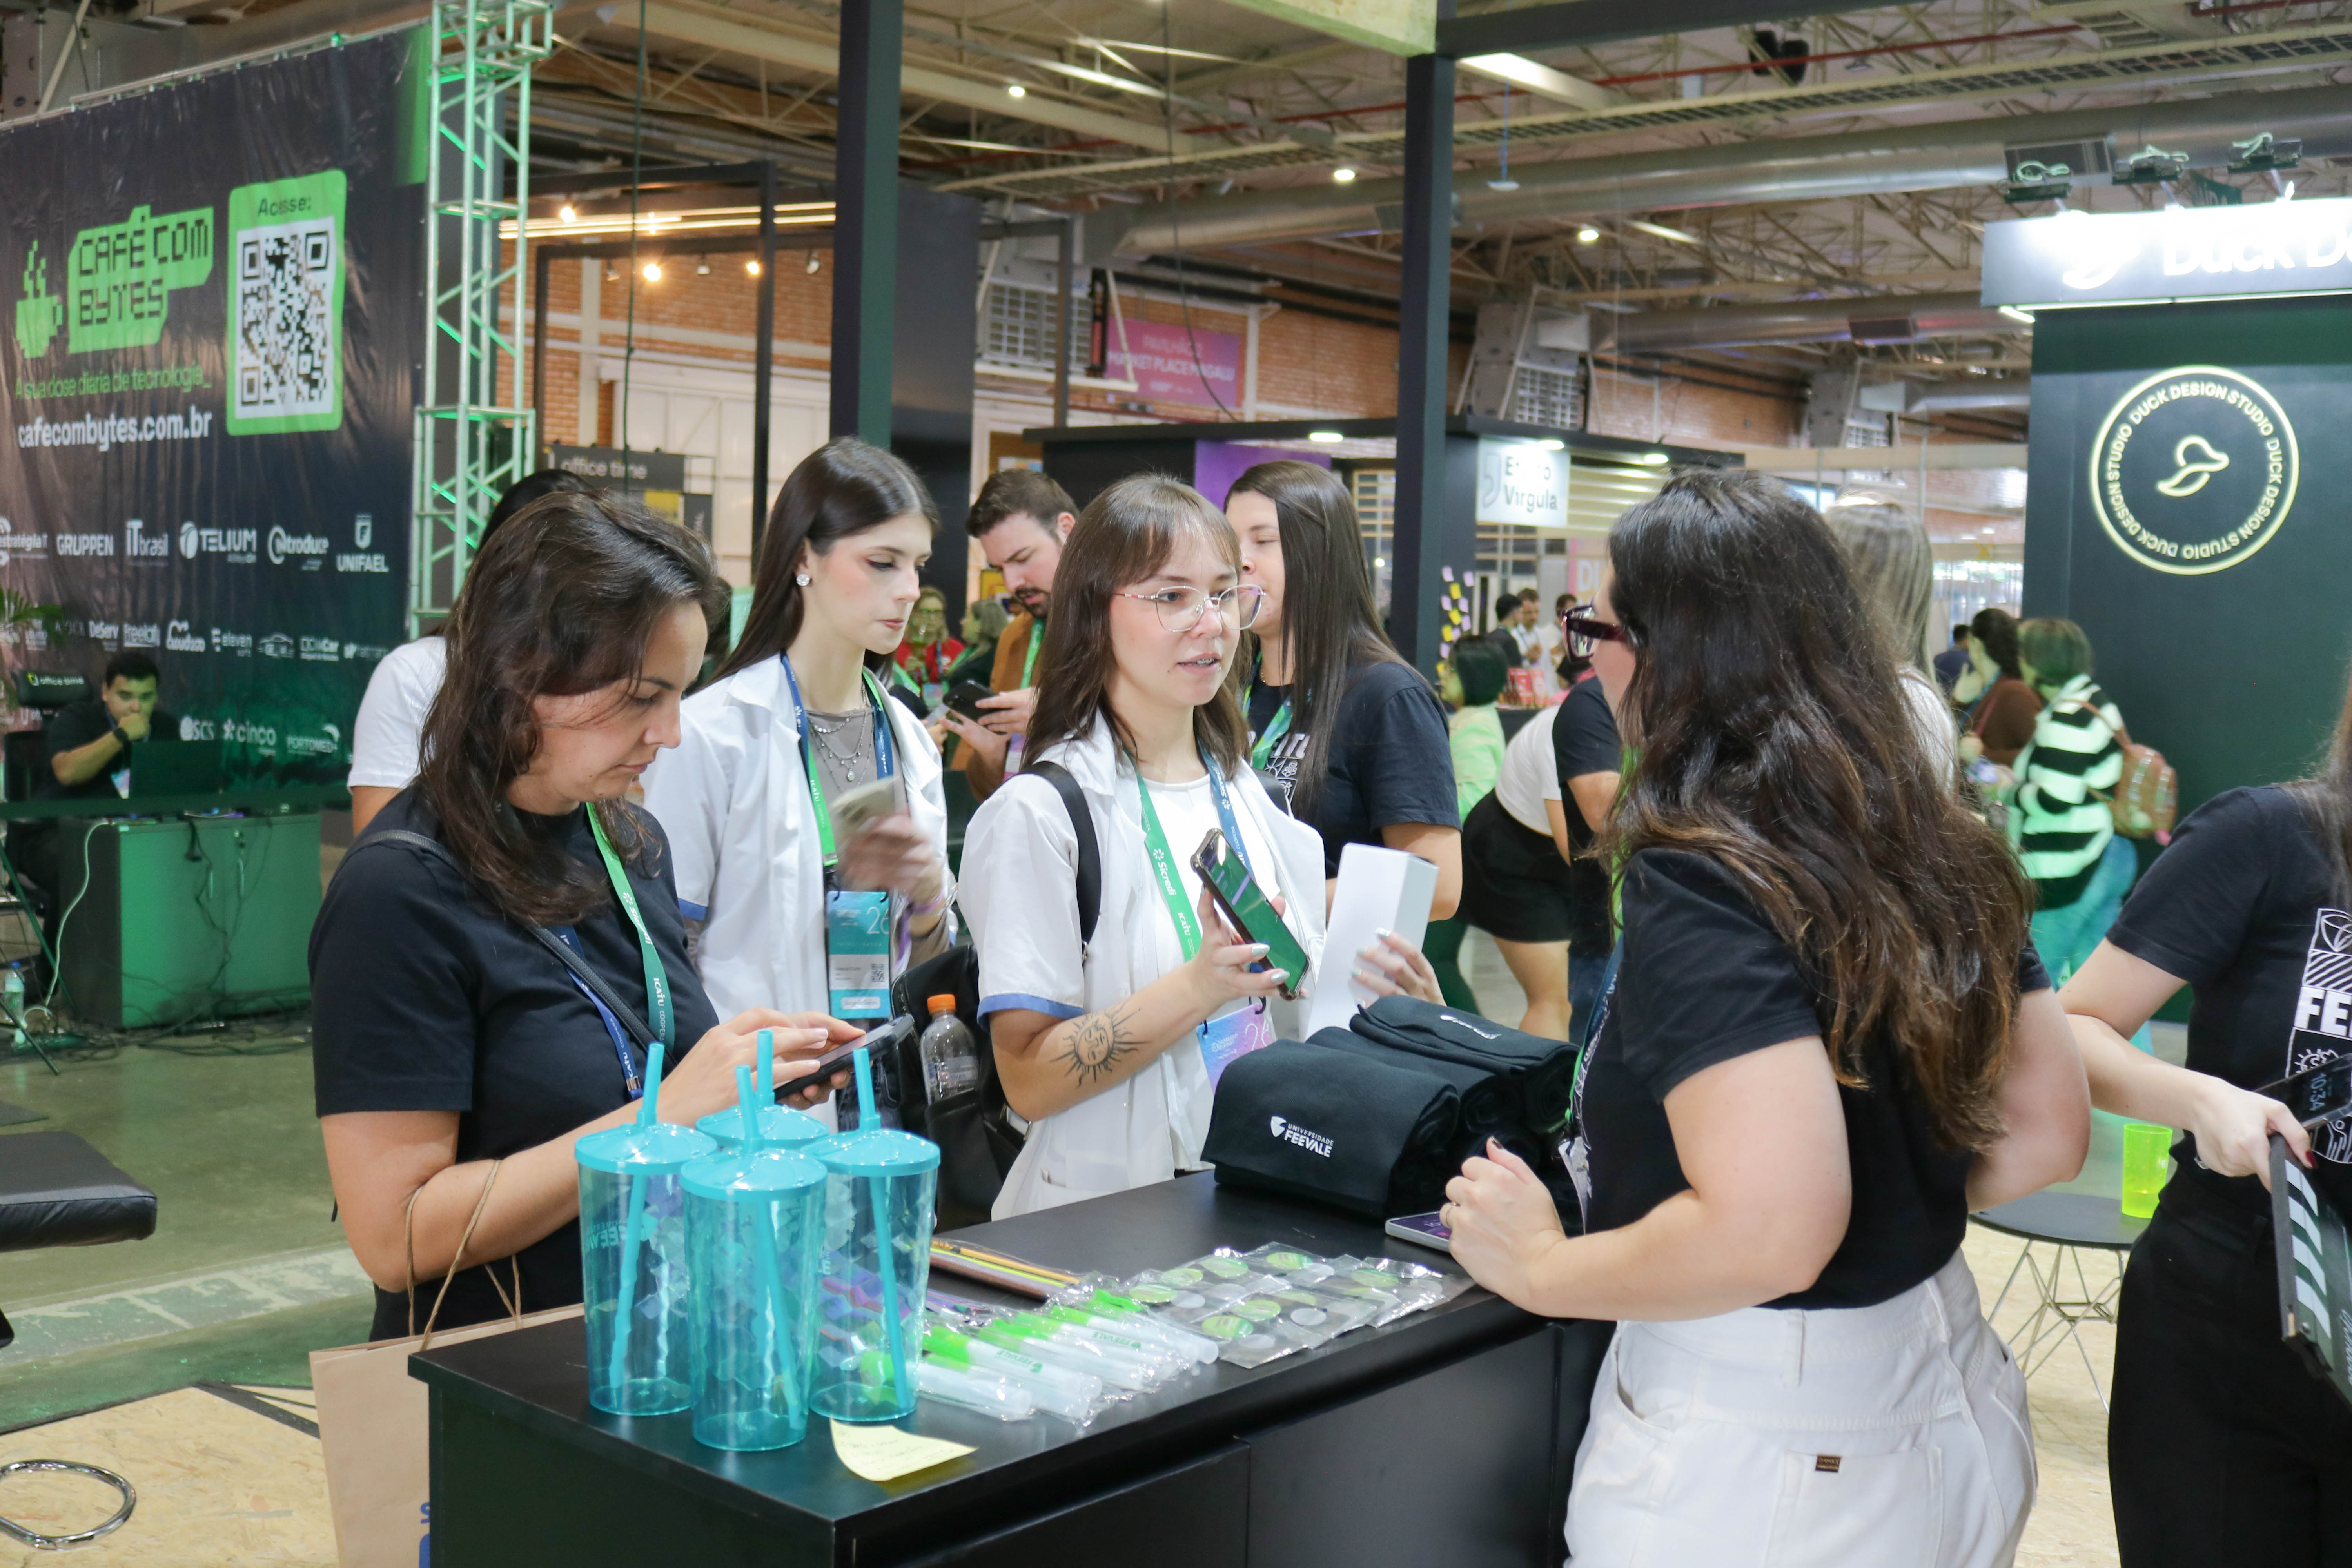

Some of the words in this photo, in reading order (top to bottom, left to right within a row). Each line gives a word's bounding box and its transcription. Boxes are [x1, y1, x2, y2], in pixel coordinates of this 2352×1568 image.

[154, 219, 208, 265] COM
[80, 278, 163, 327] BYTES
[49, 373, 76, 397] dose
[113, 367, 130, 392] de
[18, 404, 213, 452] cafecombytes.com.br
[2129, 389, 2170, 426] DUCK
[2169, 381, 2228, 401] DESIGN
[2227, 389, 2274, 437] STUDIO
[2107, 423, 2133, 481] STUDIO
[2266, 436, 2283, 485] DUCK
[2107, 482, 2142, 536] DESIGN
[2238, 486, 2280, 540] DESIGN
[56, 533, 114, 556] GRUPPEN
[199, 528, 257, 552] TELIUM
[336, 552, 389, 573] UNIFAEL
[2136, 527, 2180, 558] DUCK
[2182, 531, 2241, 561] STUDIO
[1158, 862, 1177, 896] Sicredi
[1177, 912, 1191, 936] ICATU
[653, 978, 665, 1007] ICATU
[2294, 986, 2352, 1038] FE
[1283, 1129, 1333, 1158] FEEVALE
[1287, 1123, 1334, 1147] UNIVERSIDADE
